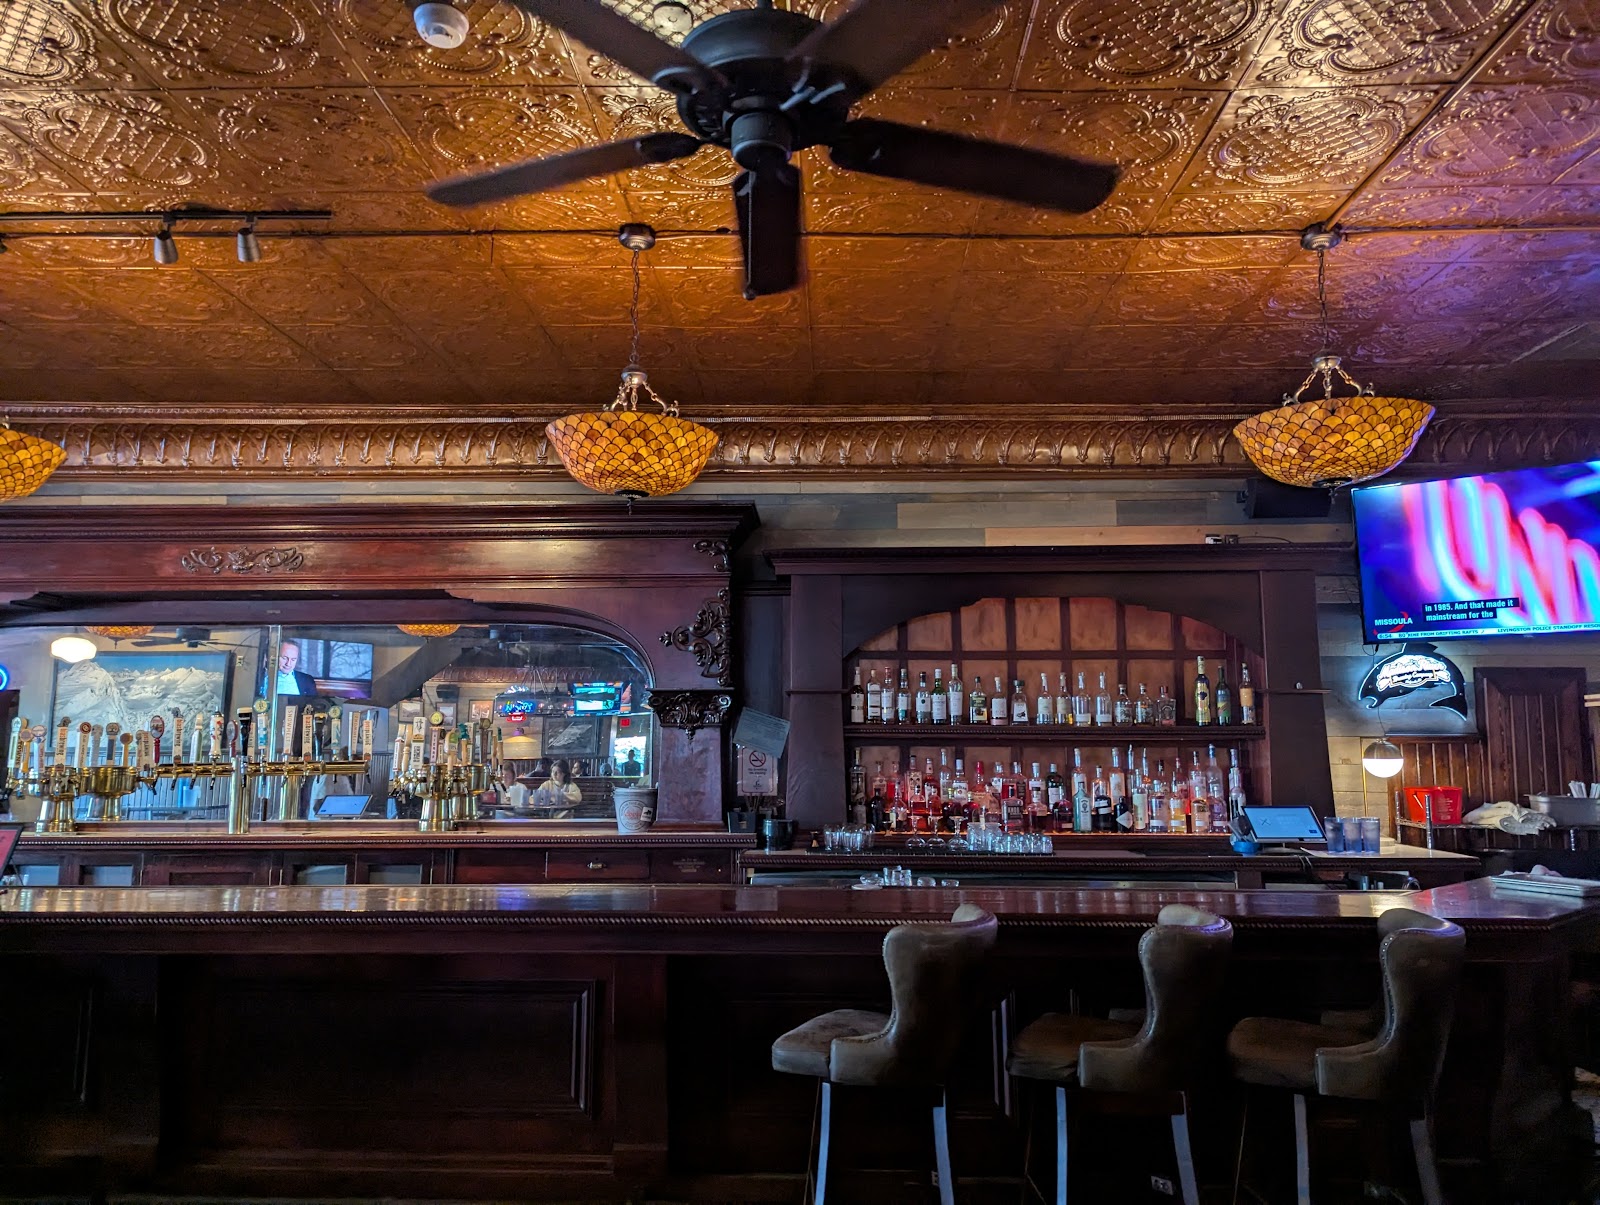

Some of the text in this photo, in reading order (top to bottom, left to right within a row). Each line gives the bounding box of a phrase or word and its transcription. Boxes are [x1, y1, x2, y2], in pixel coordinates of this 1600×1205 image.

[1425, 599, 1514, 612] in 1985. And that made it
[1426, 613, 1467, 621] mainstream
[1481, 610, 1494, 618] the
[1374, 617, 1413, 626] MISSOULA
